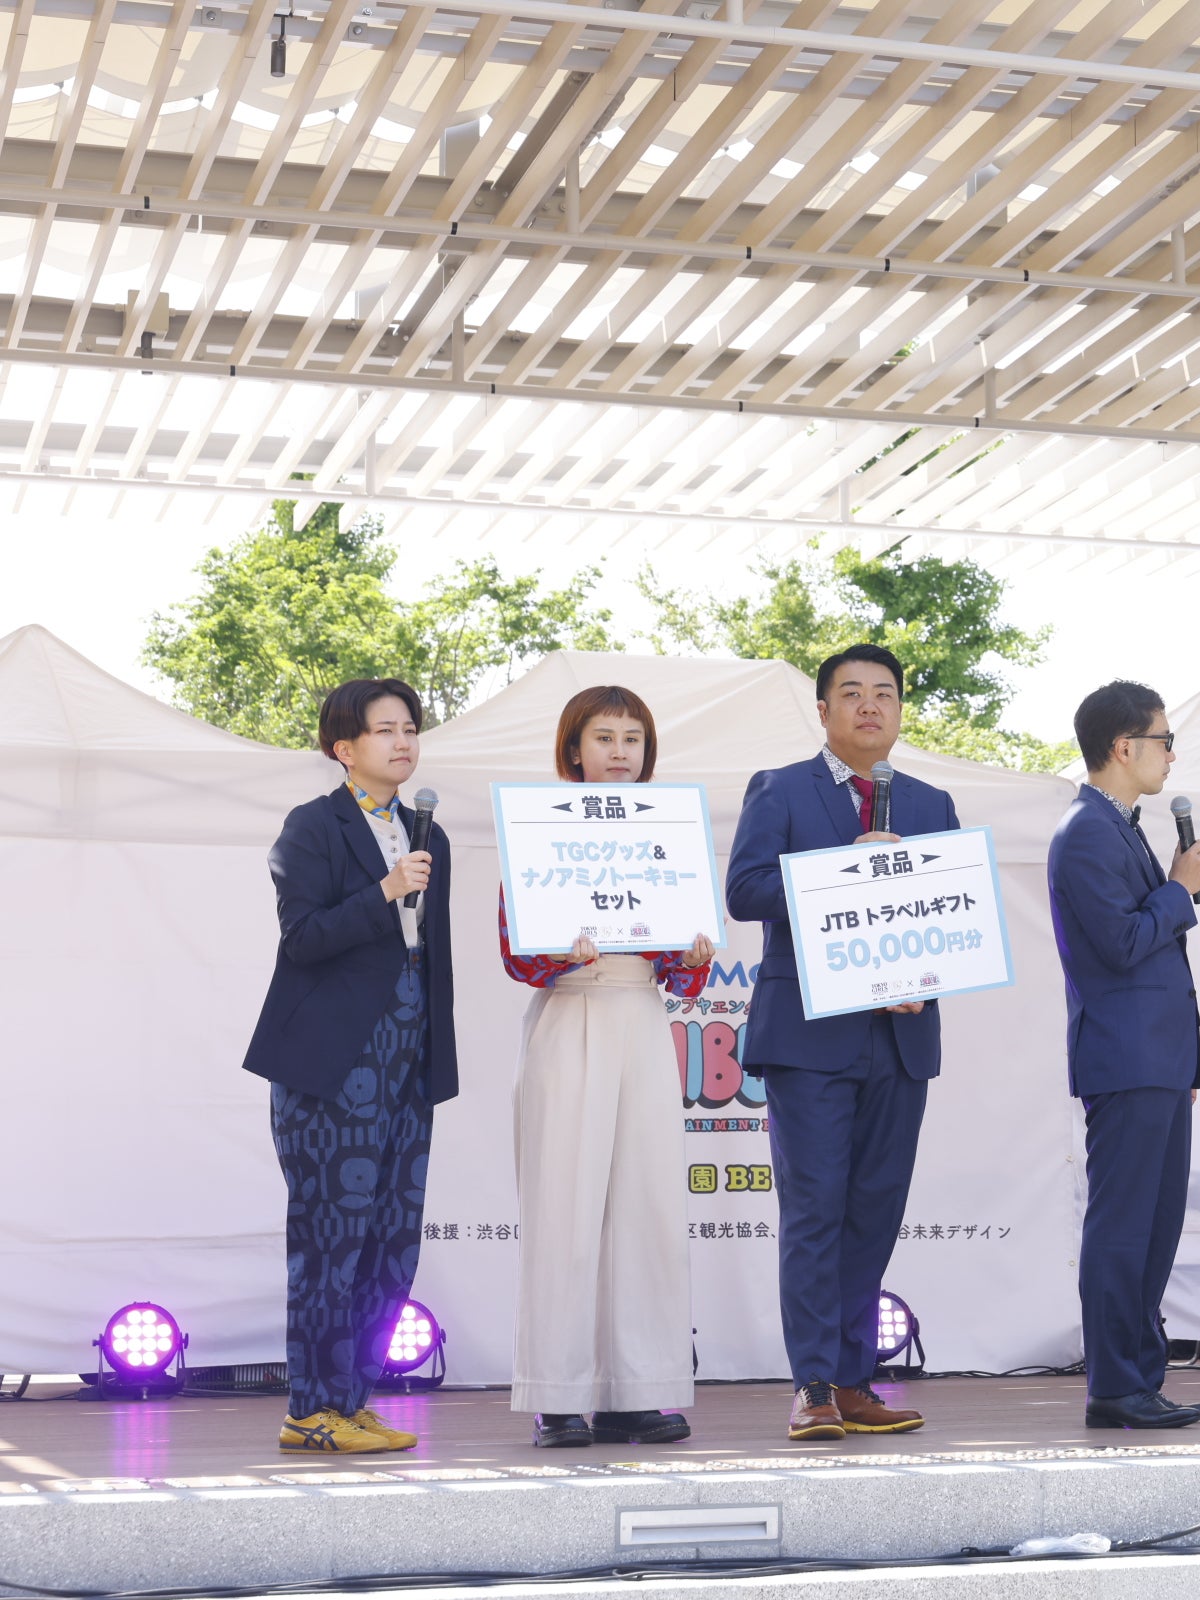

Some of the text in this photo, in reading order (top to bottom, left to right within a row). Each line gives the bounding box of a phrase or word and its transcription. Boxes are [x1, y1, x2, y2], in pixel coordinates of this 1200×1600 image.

[581, 795, 627, 819] 賞品
[551, 840, 667, 862] TGCグッズ&
[868, 850, 914, 878] 賞品
[520, 866, 697, 889] ナノアミノトーキョー
[590, 890, 641, 910] セット
[820, 892, 977, 933] JTB トラベルギフト
[825, 926, 983, 972] 50,000円分
[688, 1164, 718, 1194] 園
